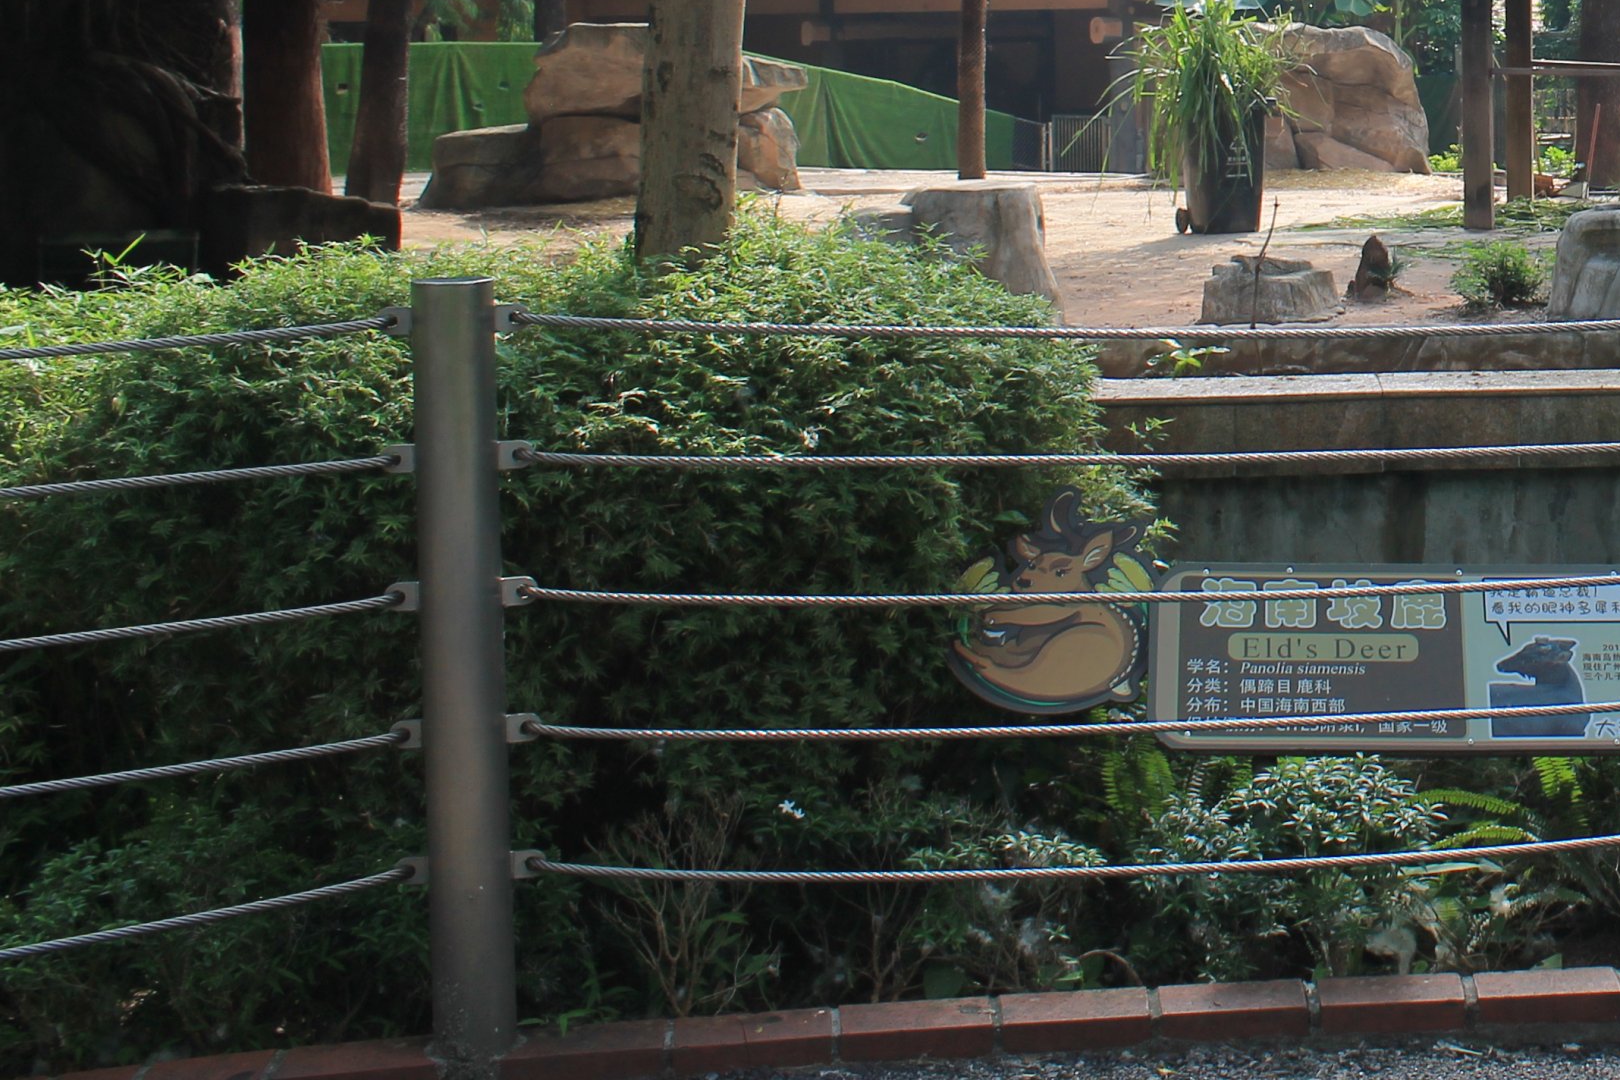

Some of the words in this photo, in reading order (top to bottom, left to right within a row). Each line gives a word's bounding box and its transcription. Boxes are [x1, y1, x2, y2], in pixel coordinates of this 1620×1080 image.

[1200, 578, 1447, 629] 海南坡鹿
[1242, 637, 1318, 659] Eld's
[1335, 638, 1407, 659] Deer
[1240, 661, 1293, 675] Panolia
[1297, 661, 1366, 675] siamensis
[1296, 678, 1332, 694] 鹿科
